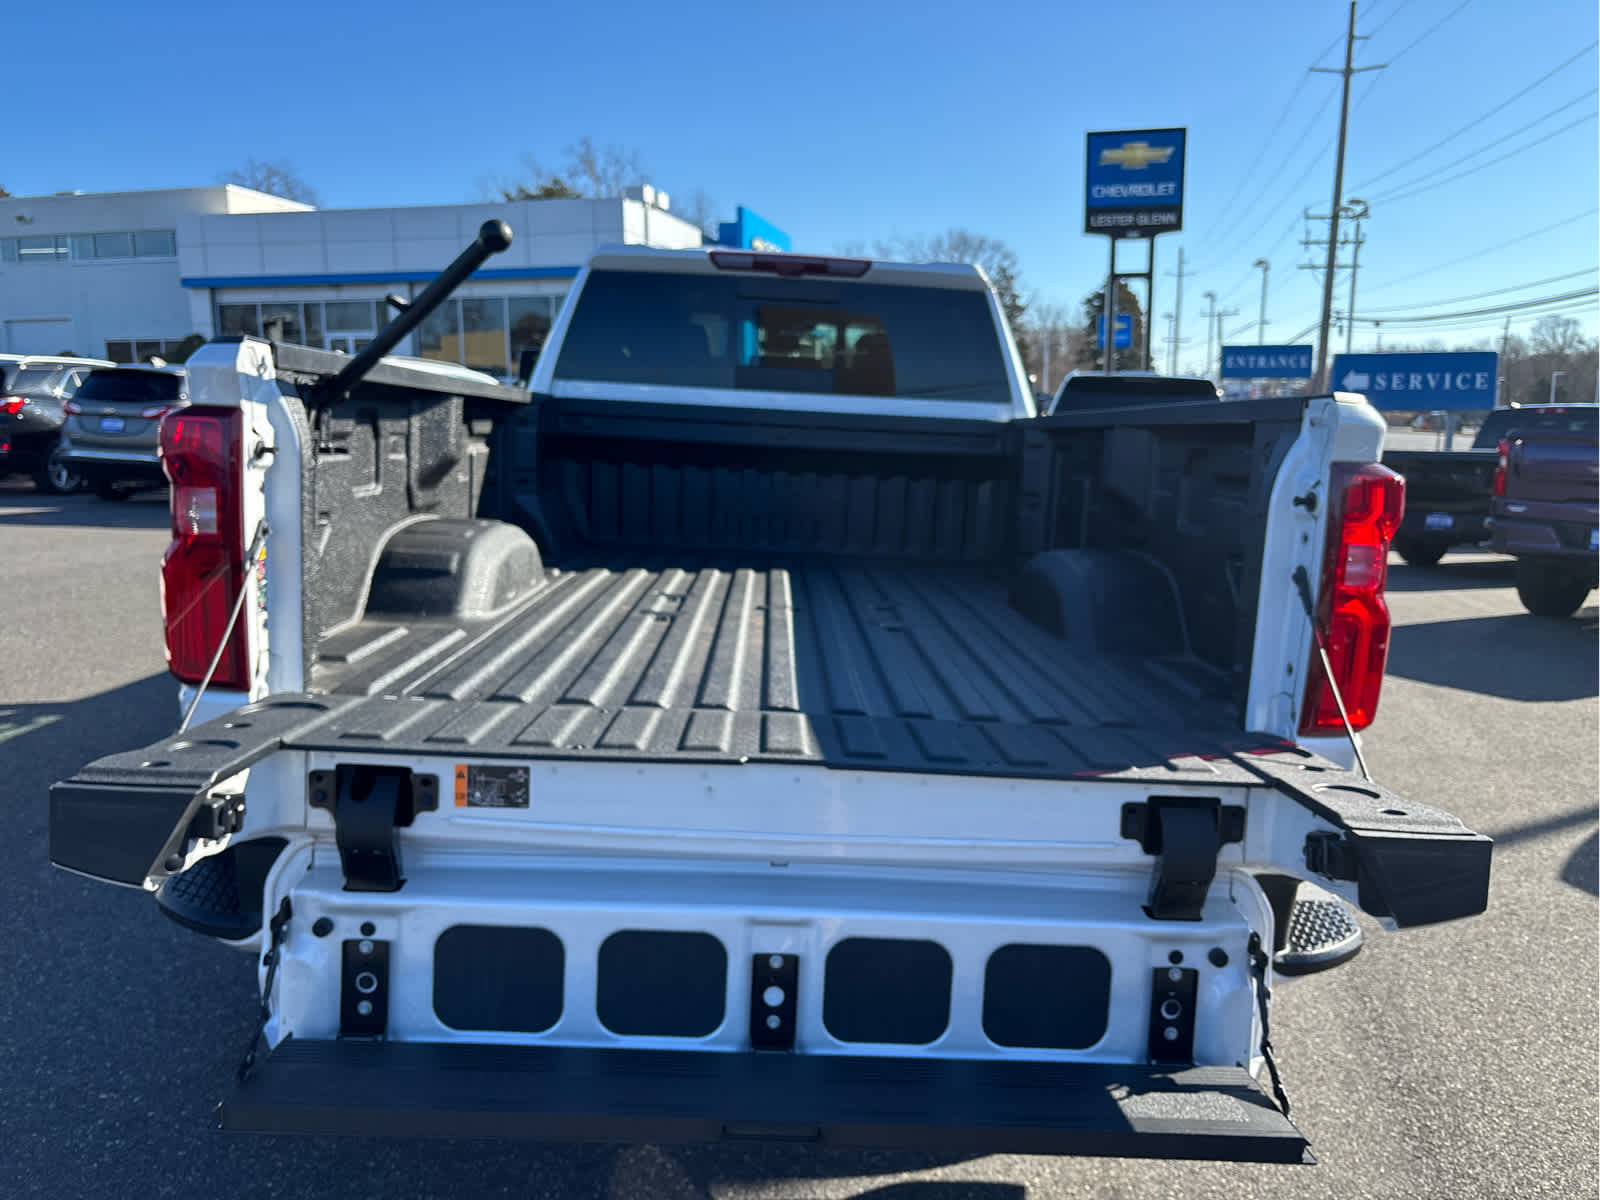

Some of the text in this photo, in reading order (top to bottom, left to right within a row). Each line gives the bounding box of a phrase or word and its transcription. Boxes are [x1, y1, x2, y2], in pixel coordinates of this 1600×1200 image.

[1092, 182, 1176, 198] CHEVROLET
[1135, 212, 1177, 225] GLENN
[1226, 354, 1309, 368] ENTRANCE
[1374, 372, 1489, 390] SERVICE
